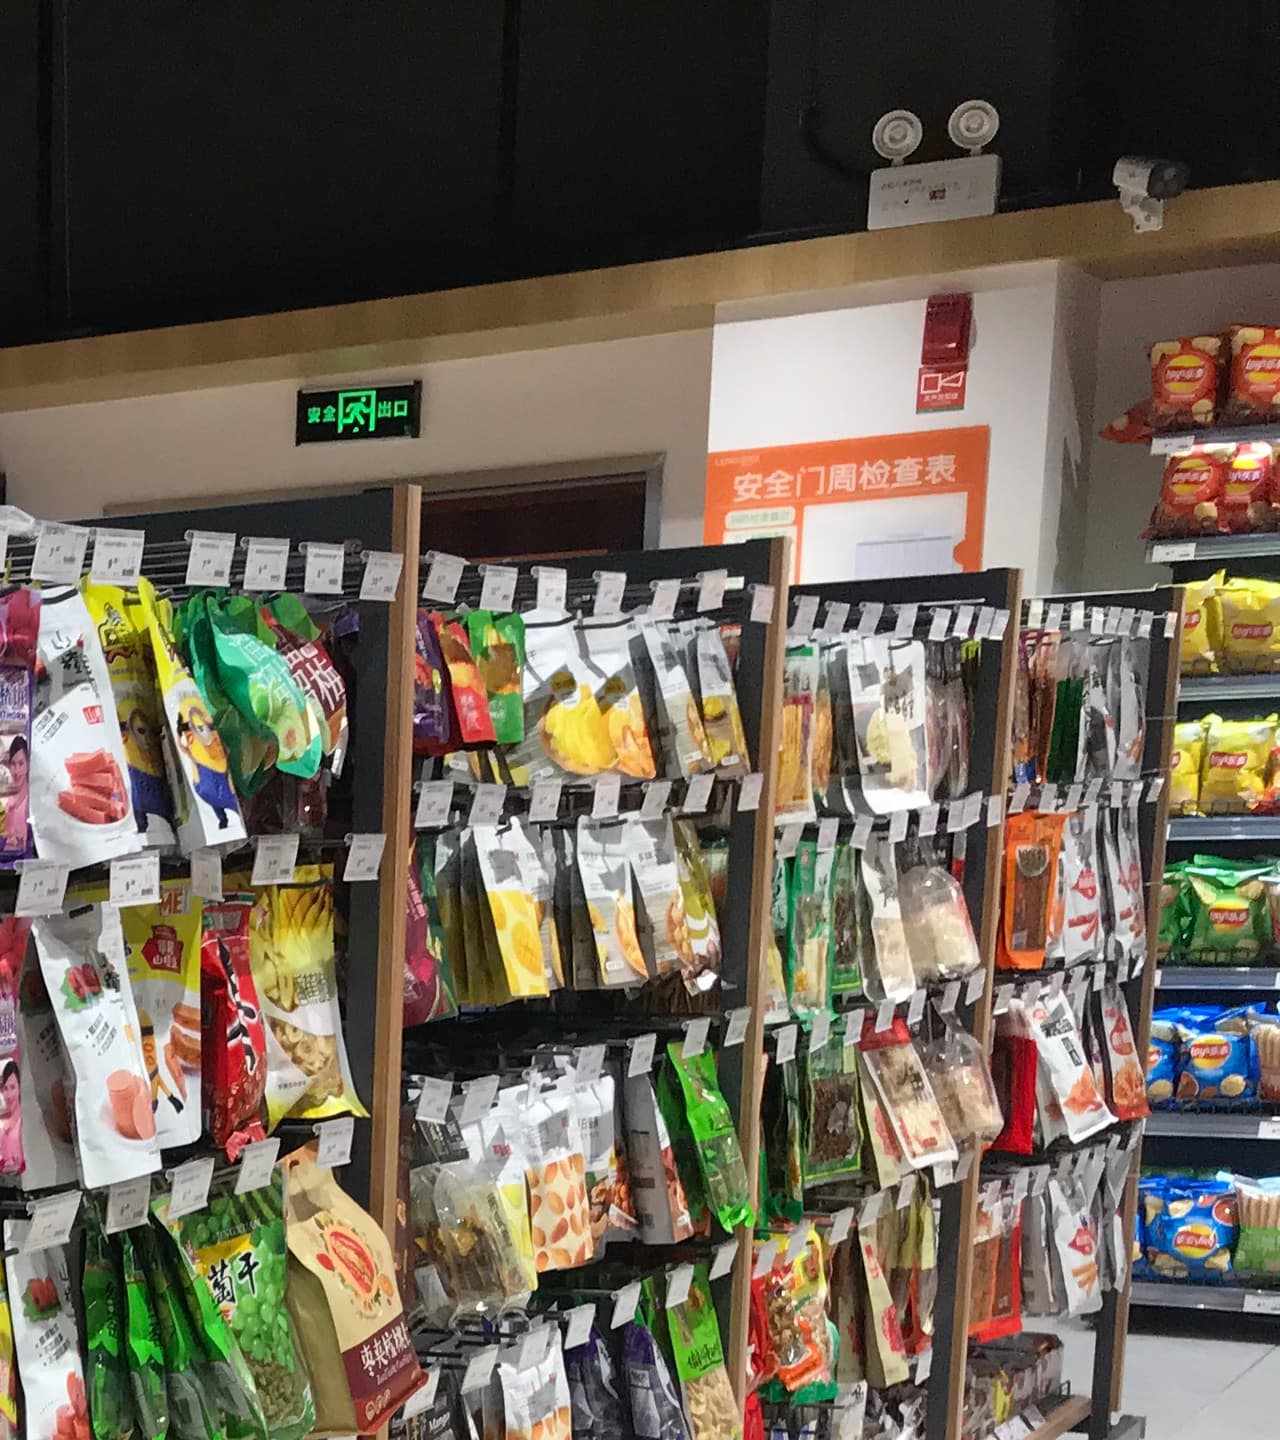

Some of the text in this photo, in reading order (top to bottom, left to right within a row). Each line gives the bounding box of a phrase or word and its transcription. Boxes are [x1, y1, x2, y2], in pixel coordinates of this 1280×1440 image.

[378, 400, 408, 418] 出口
[733, 454, 956, 503] 安全门周检查表
